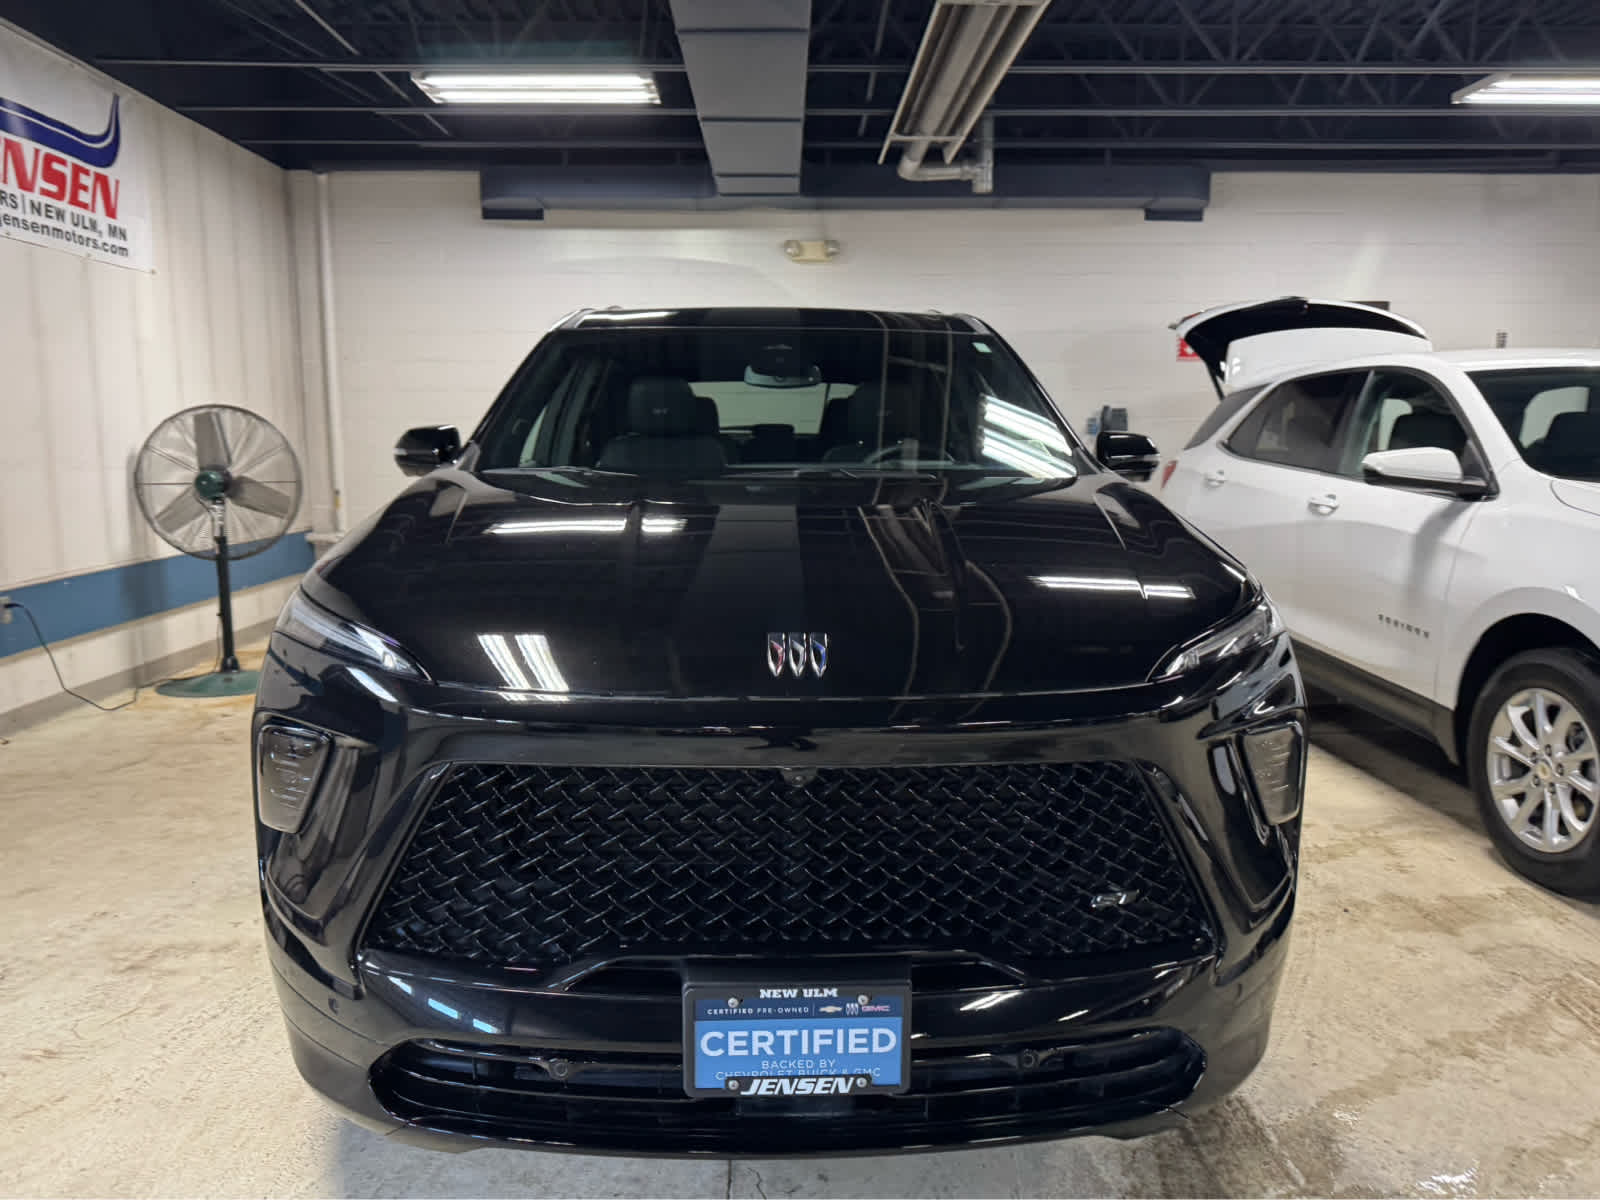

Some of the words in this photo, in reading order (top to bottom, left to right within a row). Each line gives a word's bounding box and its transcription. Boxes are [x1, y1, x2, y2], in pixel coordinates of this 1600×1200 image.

[0, 134, 120, 220] NSEN
[29, 199, 66, 222] NEW
[107, 223, 128, 241] MN
[759, 988, 799, 999] NEW
[803, 987, 838, 998] ULM
[707, 1007, 754, 1016] CERTIFIED
[757, 1006, 809, 1015] PRE-OWNED
[700, 1028, 897, 1057] CERTIFIED
[761, 1059, 815, 1069] BACKED
[819, 1058, 836, 1068] BY
[740, 1077, 855, 1096] JENSEN
